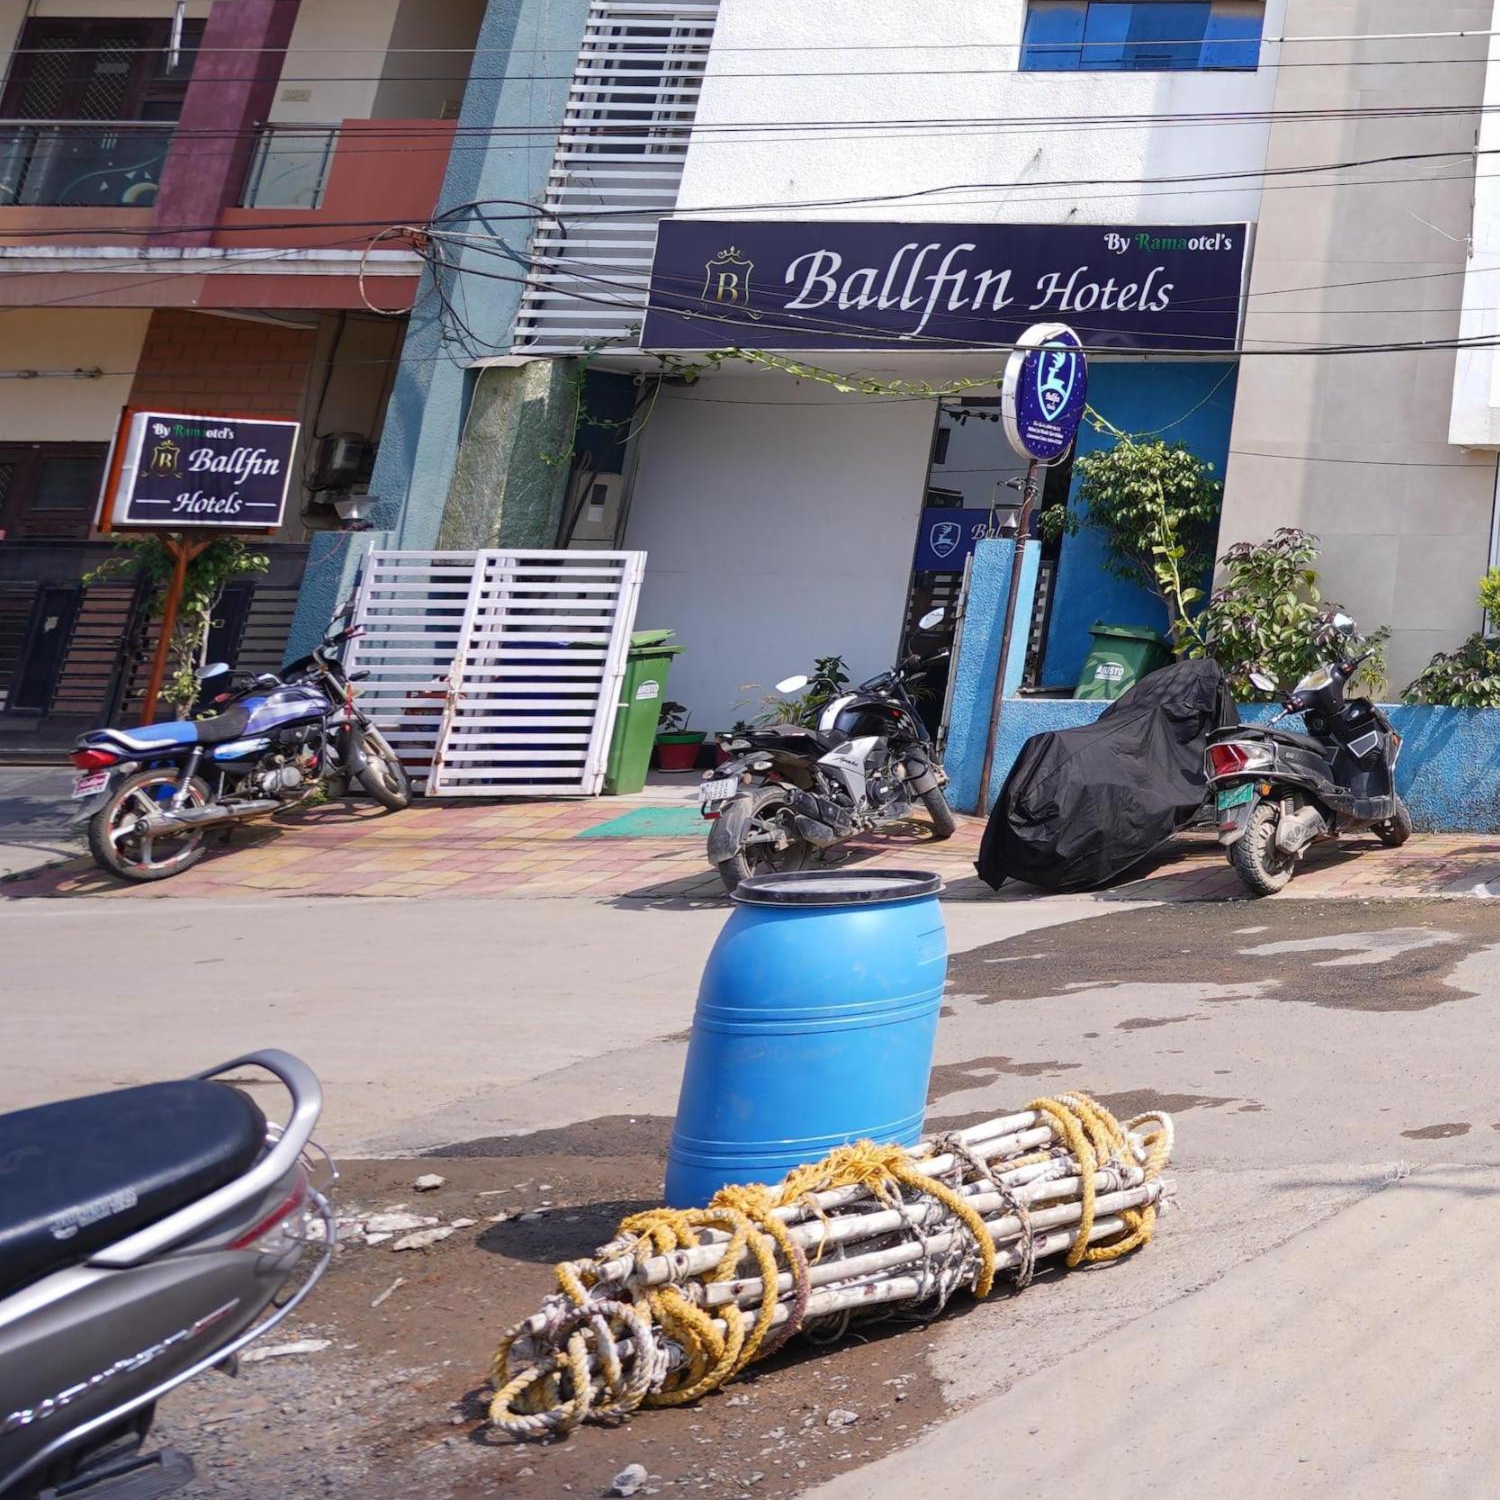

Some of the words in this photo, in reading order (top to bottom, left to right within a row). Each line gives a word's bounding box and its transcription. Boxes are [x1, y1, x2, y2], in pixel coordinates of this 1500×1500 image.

[1103, 233, 1130, 254] By
[1135, 233, 1232, 252] Ramaotel's
[784, 243, 1014, 340] Ballfin
[1028, 266, 1174, 313] Hotels
[152, 423, 171, 438] By
[173, 424, 235, 439] Ramotel's
[188, 447, 280, 485] Ballfin
[172, 490, 243, 514] Hotels
